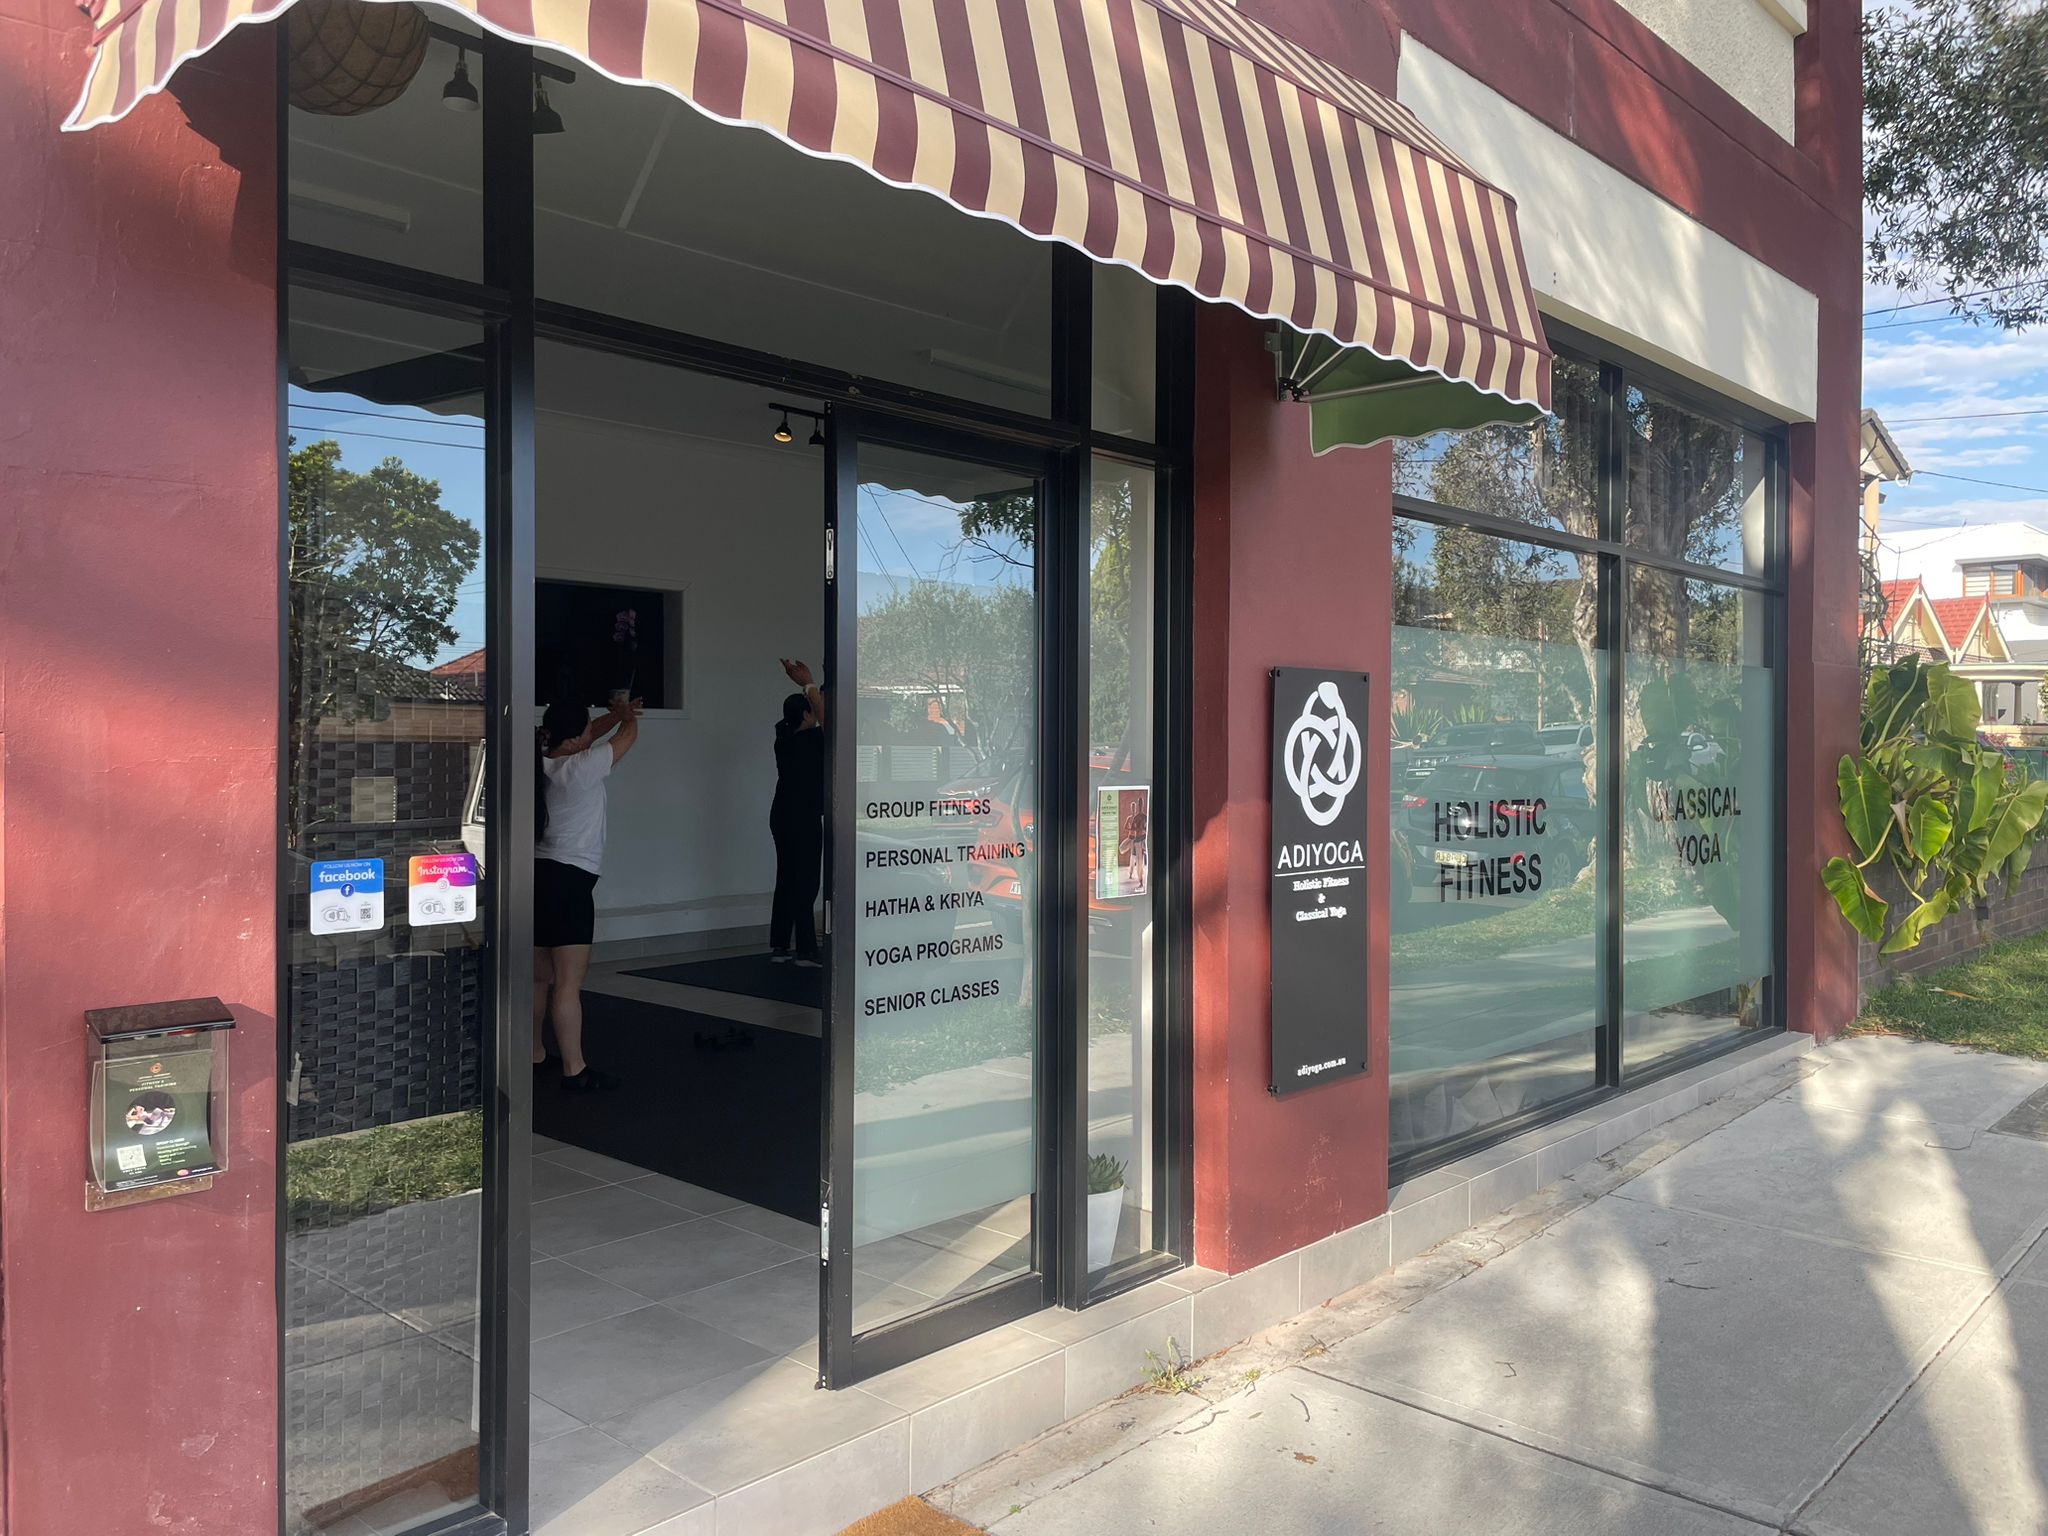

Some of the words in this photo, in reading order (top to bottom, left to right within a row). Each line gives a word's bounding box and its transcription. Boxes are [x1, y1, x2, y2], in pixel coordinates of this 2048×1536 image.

[866, 801, 925, 819] GROUP
[929, 799, 991, 817] FITNESS
[1434, 798, 1547, 843] HOLISTIC
[866, 847, 953, 868] PERSONAL
[957, 842, 1025, 862] TRAINING
[1277, 839, 1364, 869] ADIYOGA
[1676, 833, 1721, 866] YOGA
[319, 868, 375, 883] facebook
[417, 864, 467, 878] Instagram
[1293, 878, 1322, 891] Holistic
[1322, 876, 1349, 888] Fitness
[1440, 853, 1542, 902] FITNESS
[865, 896, 921, 918] HATHA
[924, 895, 935, 912] &
[940, 890, 985, 911] KRIYA
[1318, 893, 1326, 904] &
[1296, 908, 1329, 922] Classical
[1329, 906, 1347, 919] Yoga
[865, 946, 913, 967] YOGA
[917, 934, 1003, 960] PROGRAMS
[864, 992, 926, 1017] SENIOR
[930, 979, 1000, 1005] CLASSES
